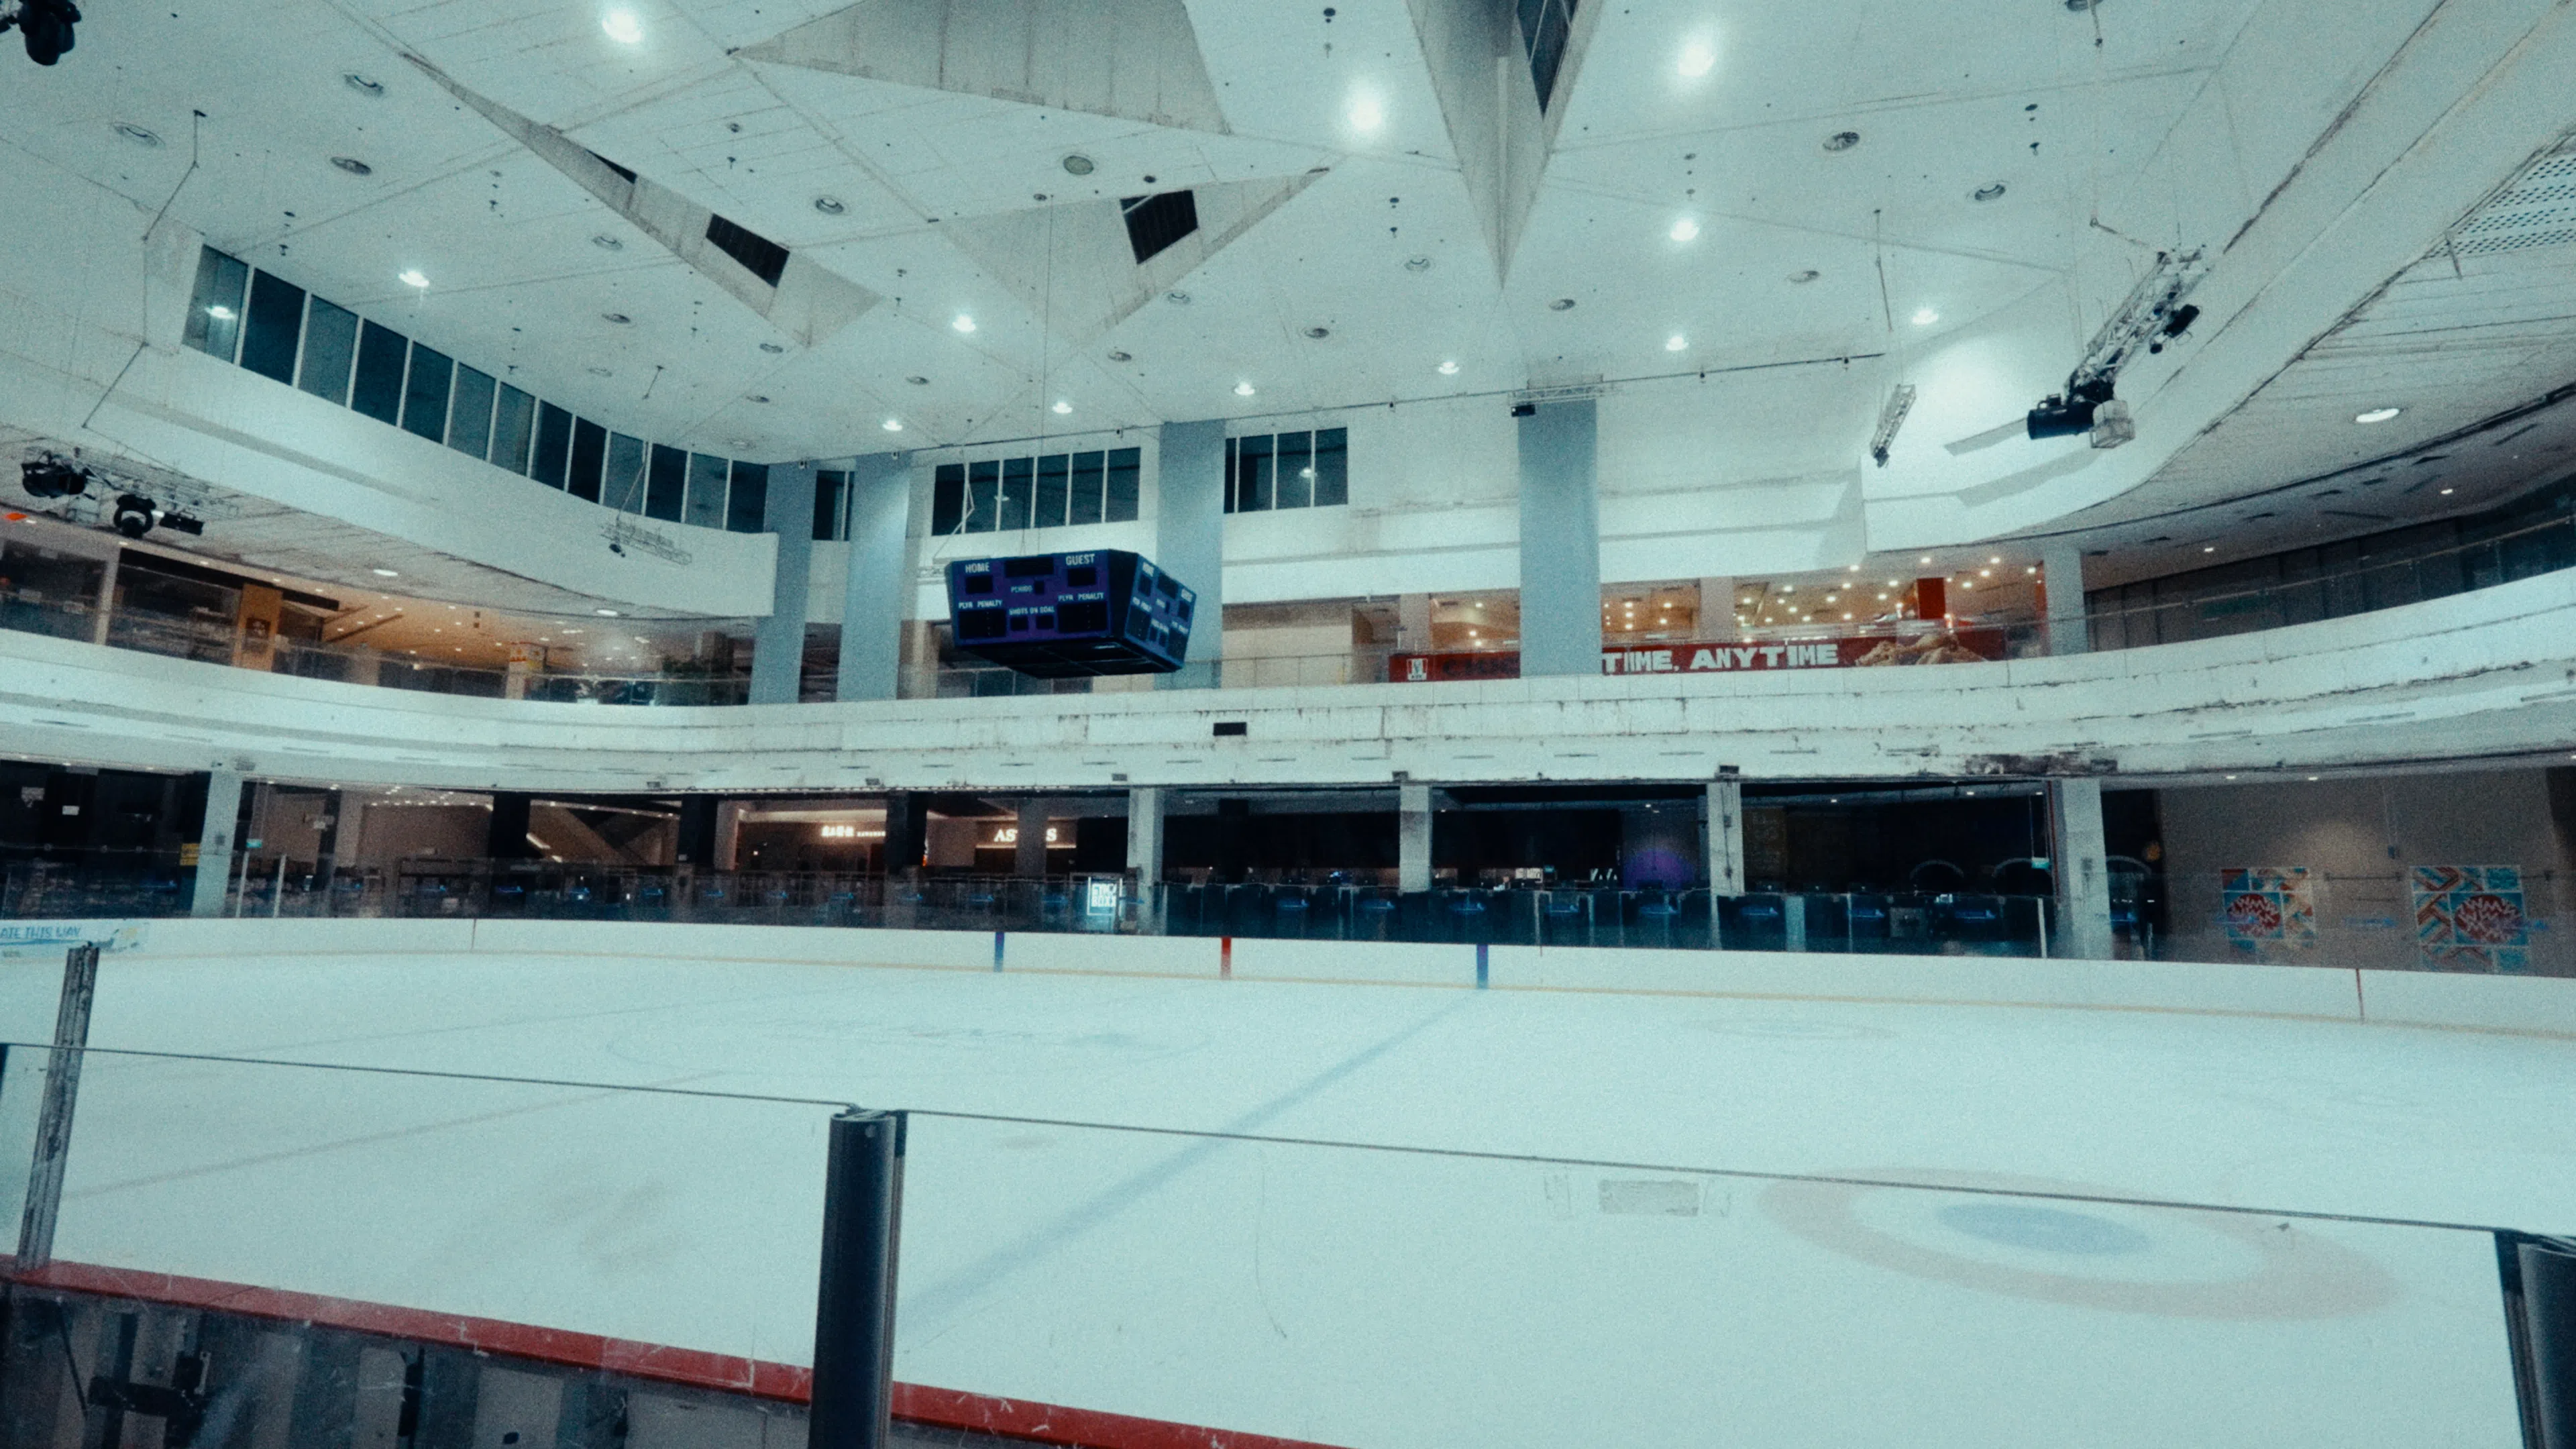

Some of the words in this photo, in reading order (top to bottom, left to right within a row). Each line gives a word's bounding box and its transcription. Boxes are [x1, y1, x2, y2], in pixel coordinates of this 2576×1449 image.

[1065, 553, 1095, 566] GUEST
[965, 562, 989, 573] HOME
[1689, 643, 1838, 669] ANYTIME
[25, 926, 53, 939] THIS
